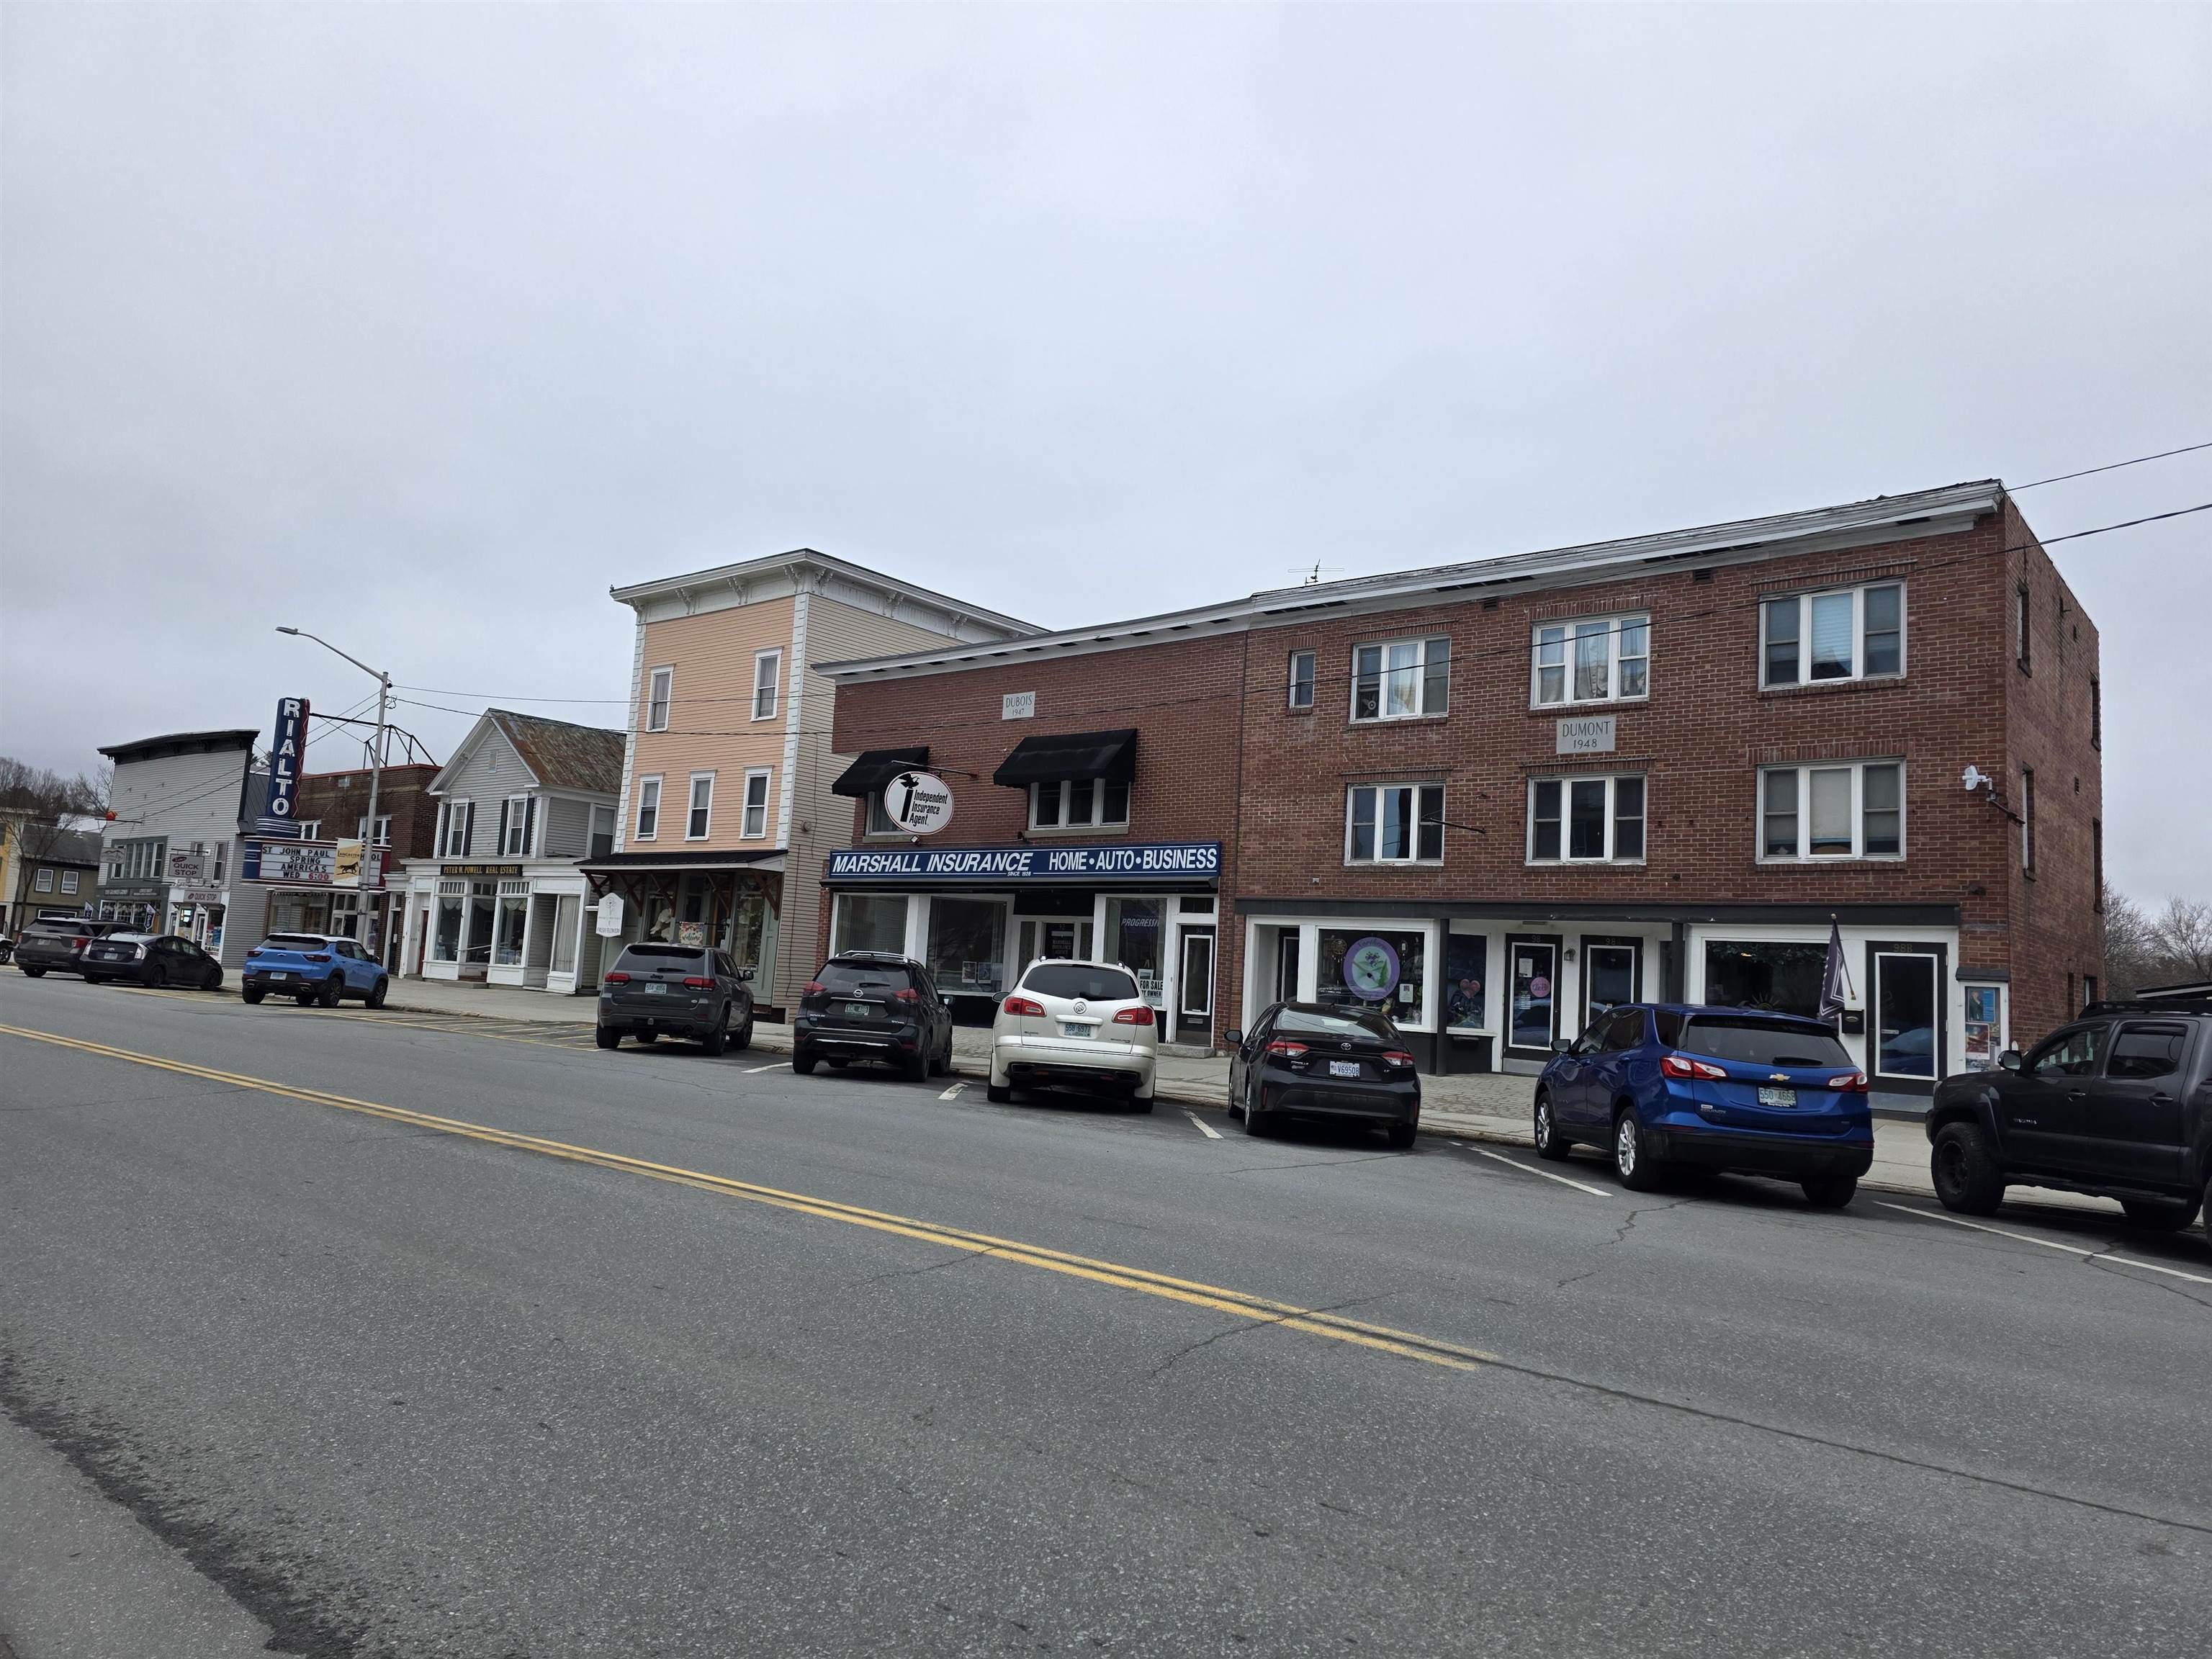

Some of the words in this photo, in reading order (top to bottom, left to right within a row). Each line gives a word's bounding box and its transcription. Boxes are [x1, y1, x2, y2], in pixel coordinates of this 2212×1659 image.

[1006, 695, 1033, 708] DUBOIS
[1563, 721, 1611, 737] DUMONT
[1573, 738, 1597, 749] 1948
[272, 699, 301, 816] RIALTO
[914, 789, 948, 804] Independent
[911, 801, 940, 814] Insurance
[289, 855, 320, 864] SPRING
[832, 854, 921, 873] MARSHALL
[926, 852, 1034, 872] INSURANCE
[464, 866, 482, 874] POWELL
[485, 866, 499, 874] REAL
[500, 866, 518, 874] ESTATE
[1121, 918, 1159, 927] PROGRESSI
[1140, 980, 1149, 989] FOR
[1151, 981, 1164, 991] SALE
[1337, 1066, 1360, 1075] V69508
[1759, 1089, 1773, 1100] 550
